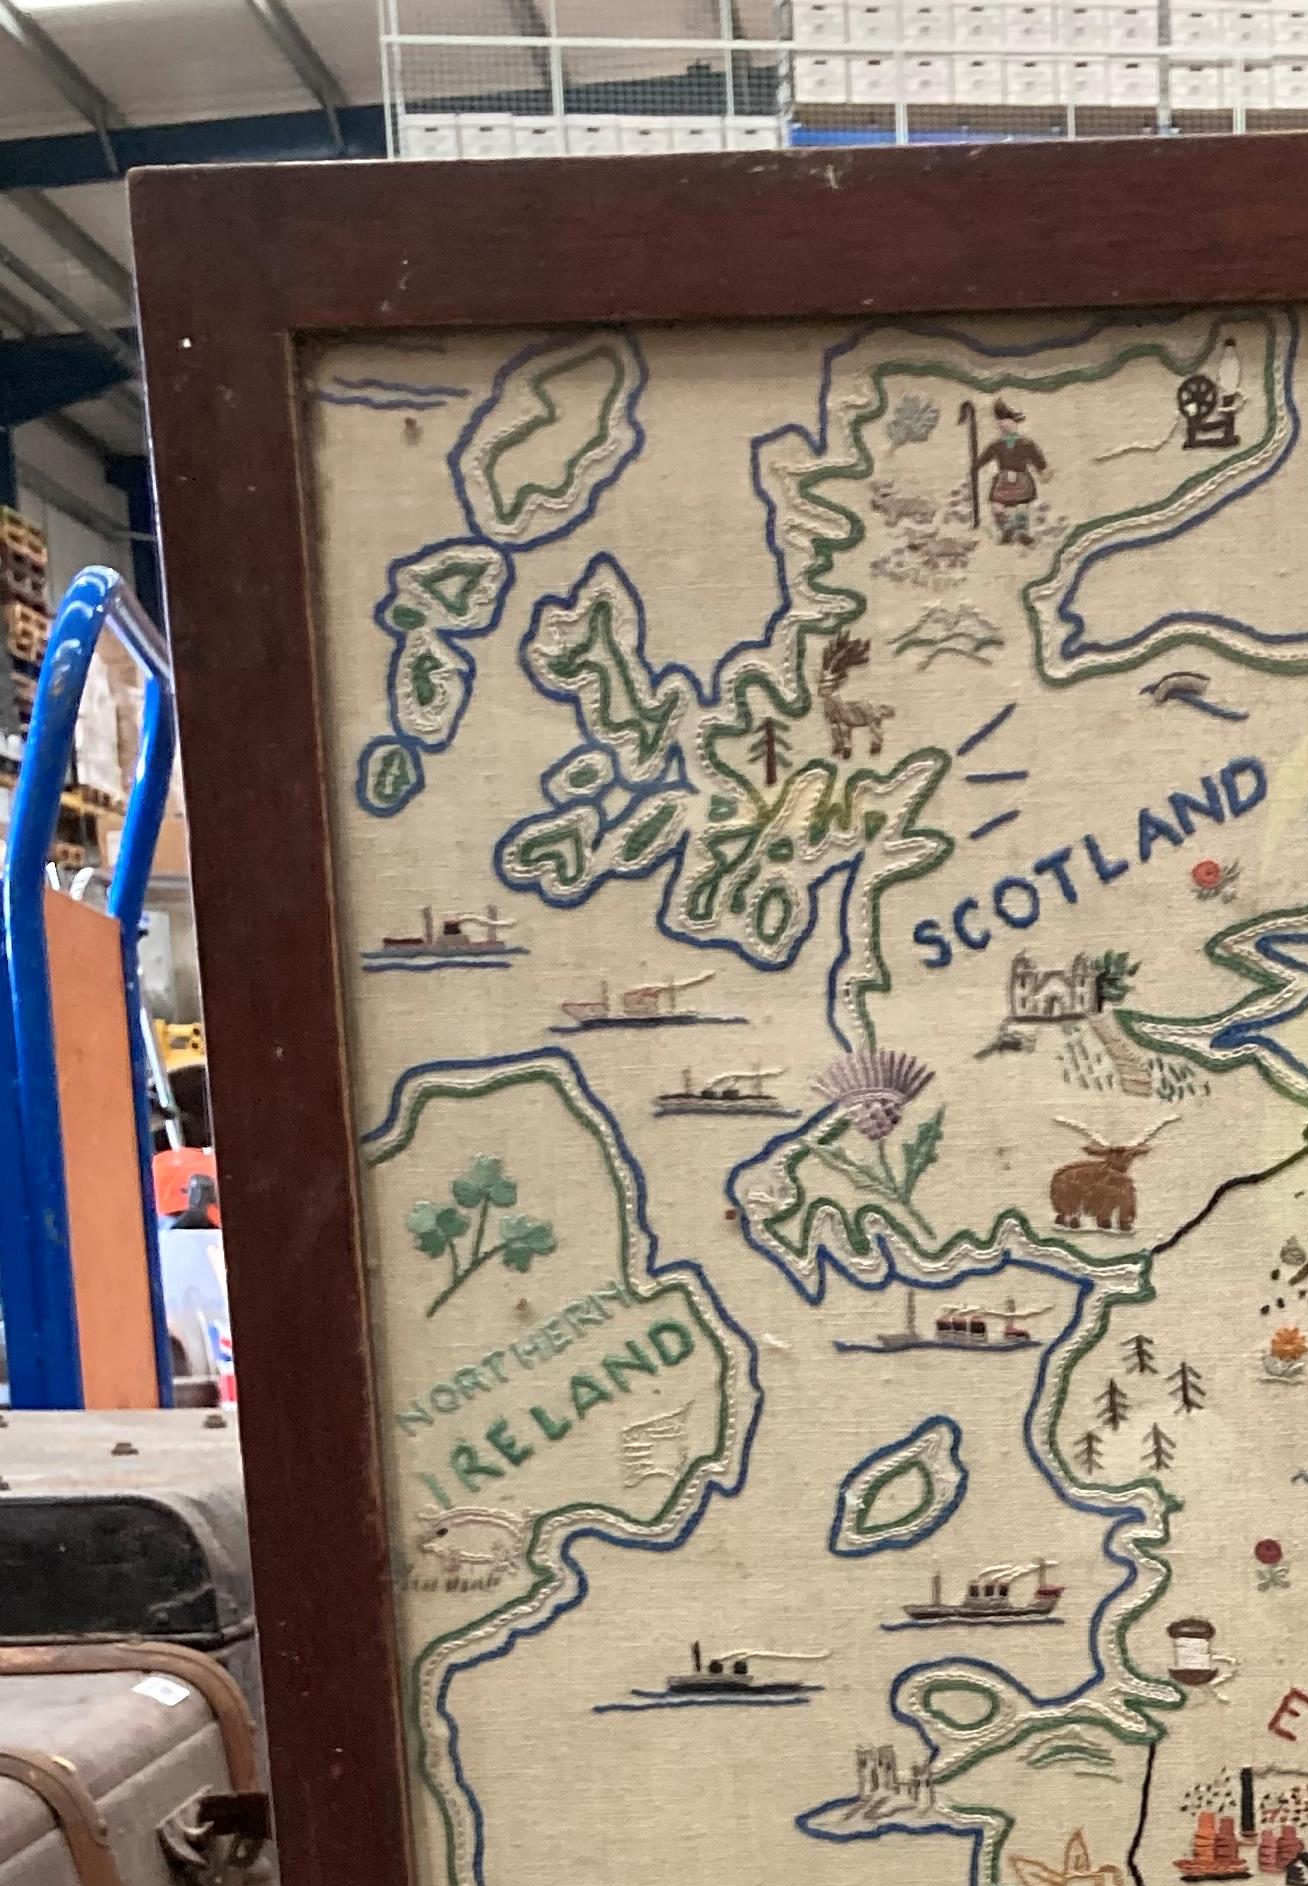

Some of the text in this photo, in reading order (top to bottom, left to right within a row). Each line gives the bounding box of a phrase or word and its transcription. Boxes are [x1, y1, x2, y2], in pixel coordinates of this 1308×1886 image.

[913, 755, 1268, 968] SCOTLAND
[396, 1280, 632, 1437] NORTHERN
[421, 1320, 695, 1510] IRELAND
